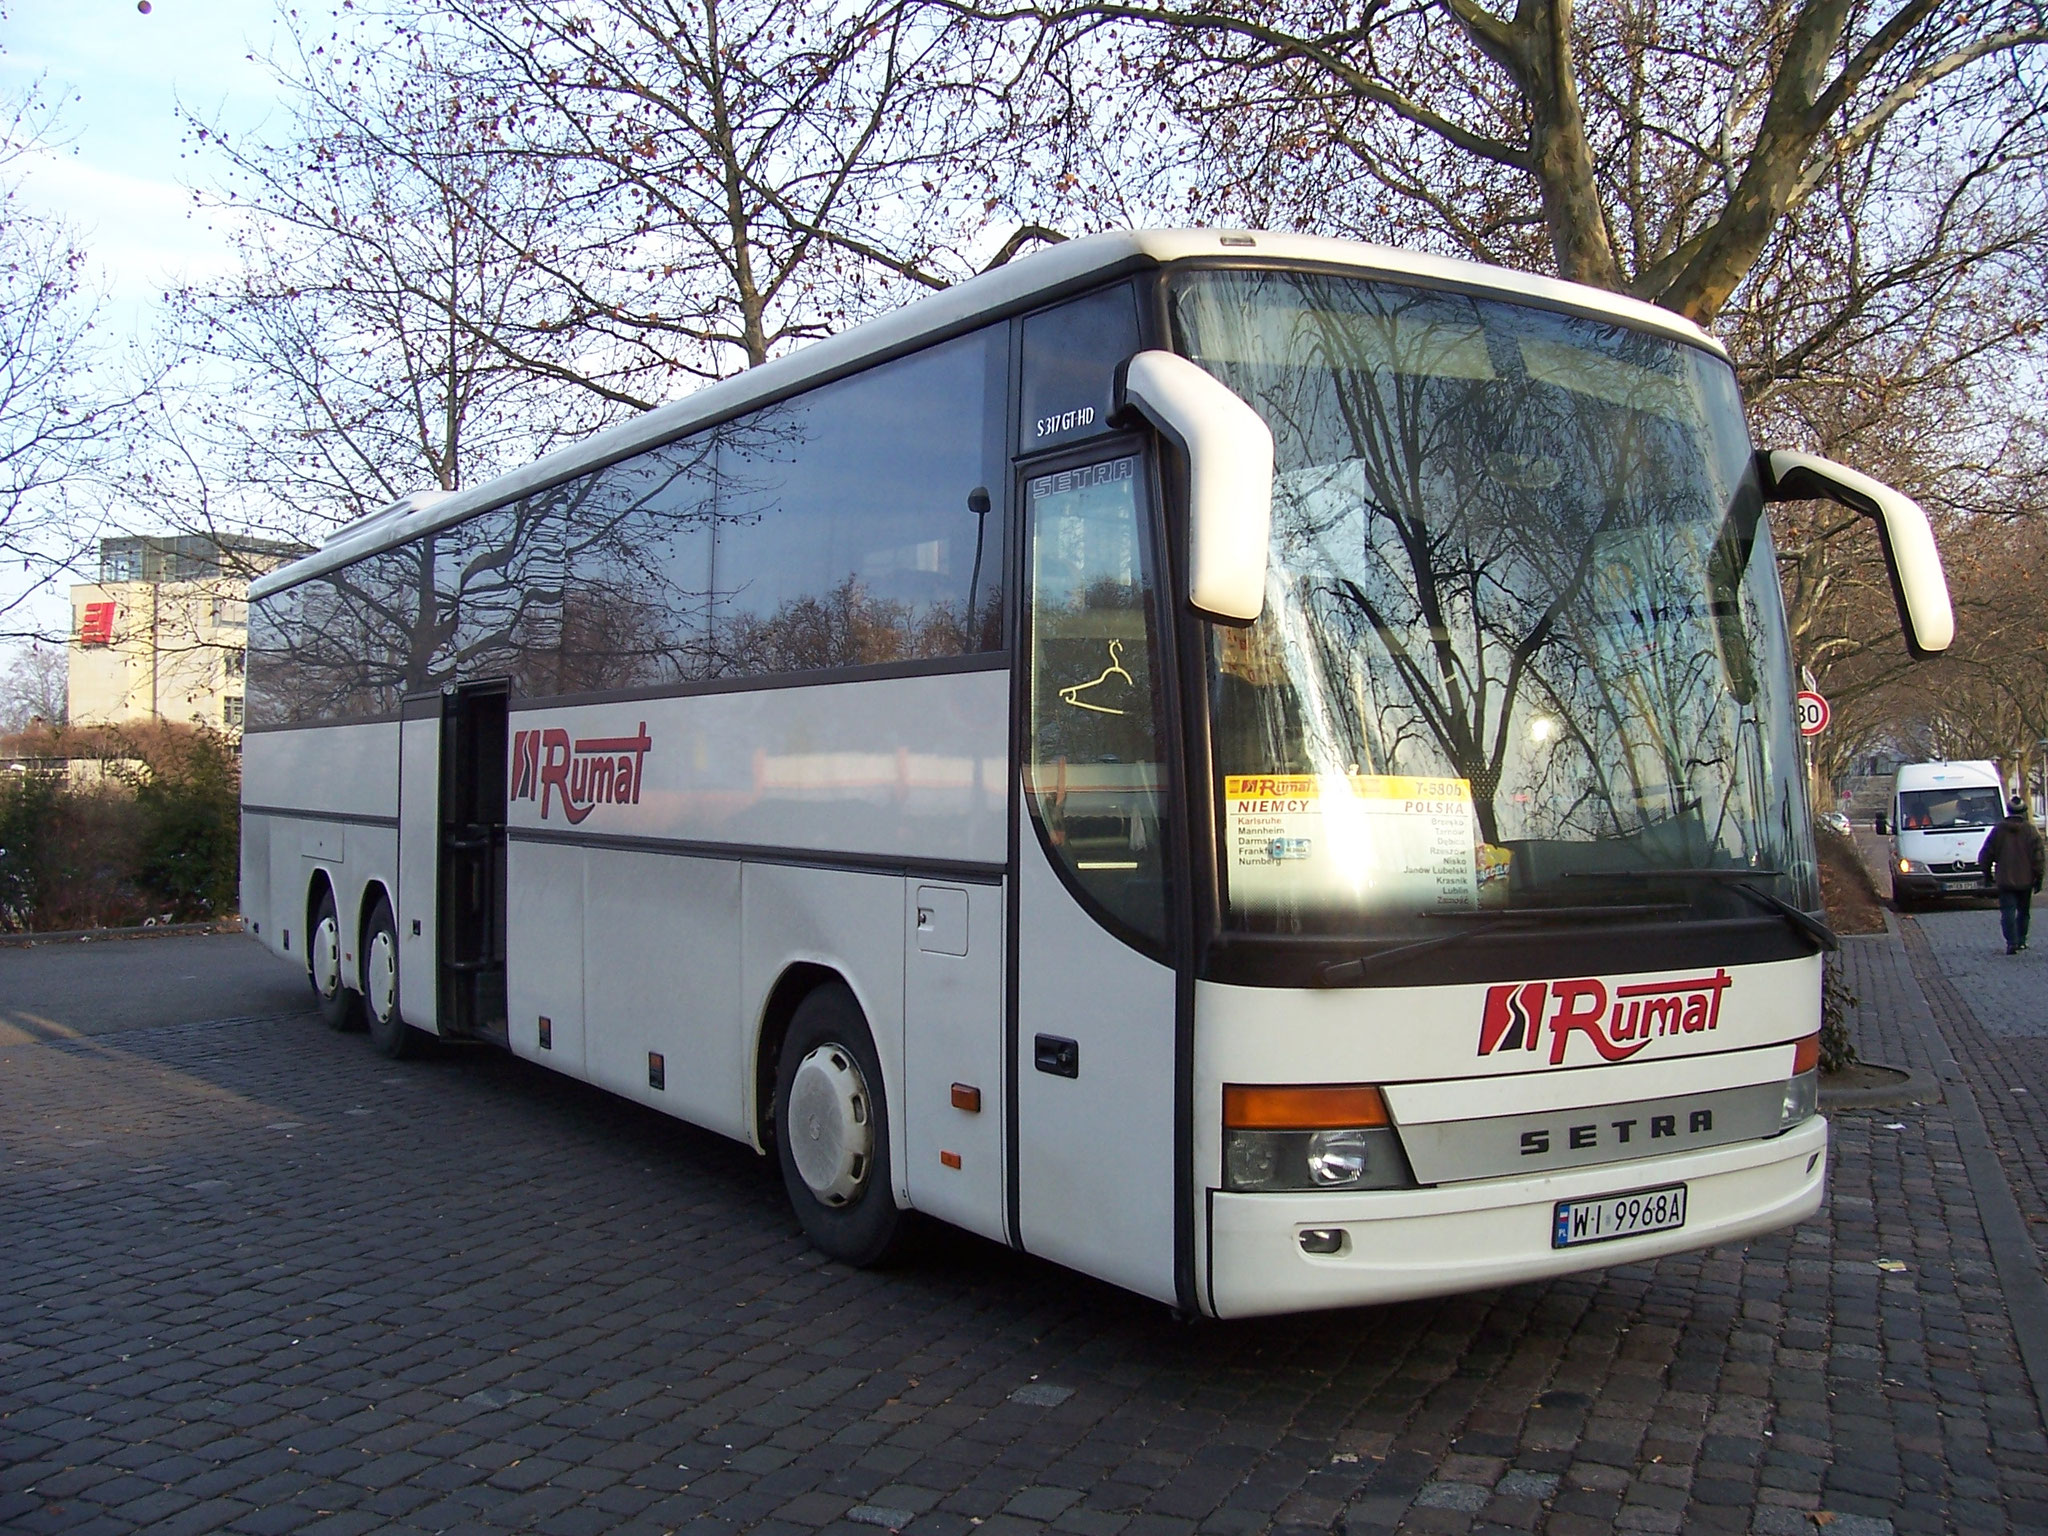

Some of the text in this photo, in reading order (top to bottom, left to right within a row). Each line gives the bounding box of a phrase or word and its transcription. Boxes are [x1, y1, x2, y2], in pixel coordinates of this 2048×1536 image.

[1033, 456, 1133, 500] SETRA
[541, 721, 652, 825] Rumat
[1238, 800, 1310, 813] NIEMCY
[1404, 801, 1464, 815] POLSKA
[1237, 817, 1282, 825] Karlsruhe
[1238, 827, 1285, 835] Mannheim
[1443, 857, 1467, 866] Nisko
[1442, 887, 1469, 895] Lublin
[1549, 968, 1732, 1065] Rumat
[1520, 1109, 1713, 1156] SETRA
[1615, 1193, 1680, 1231] 9968A
